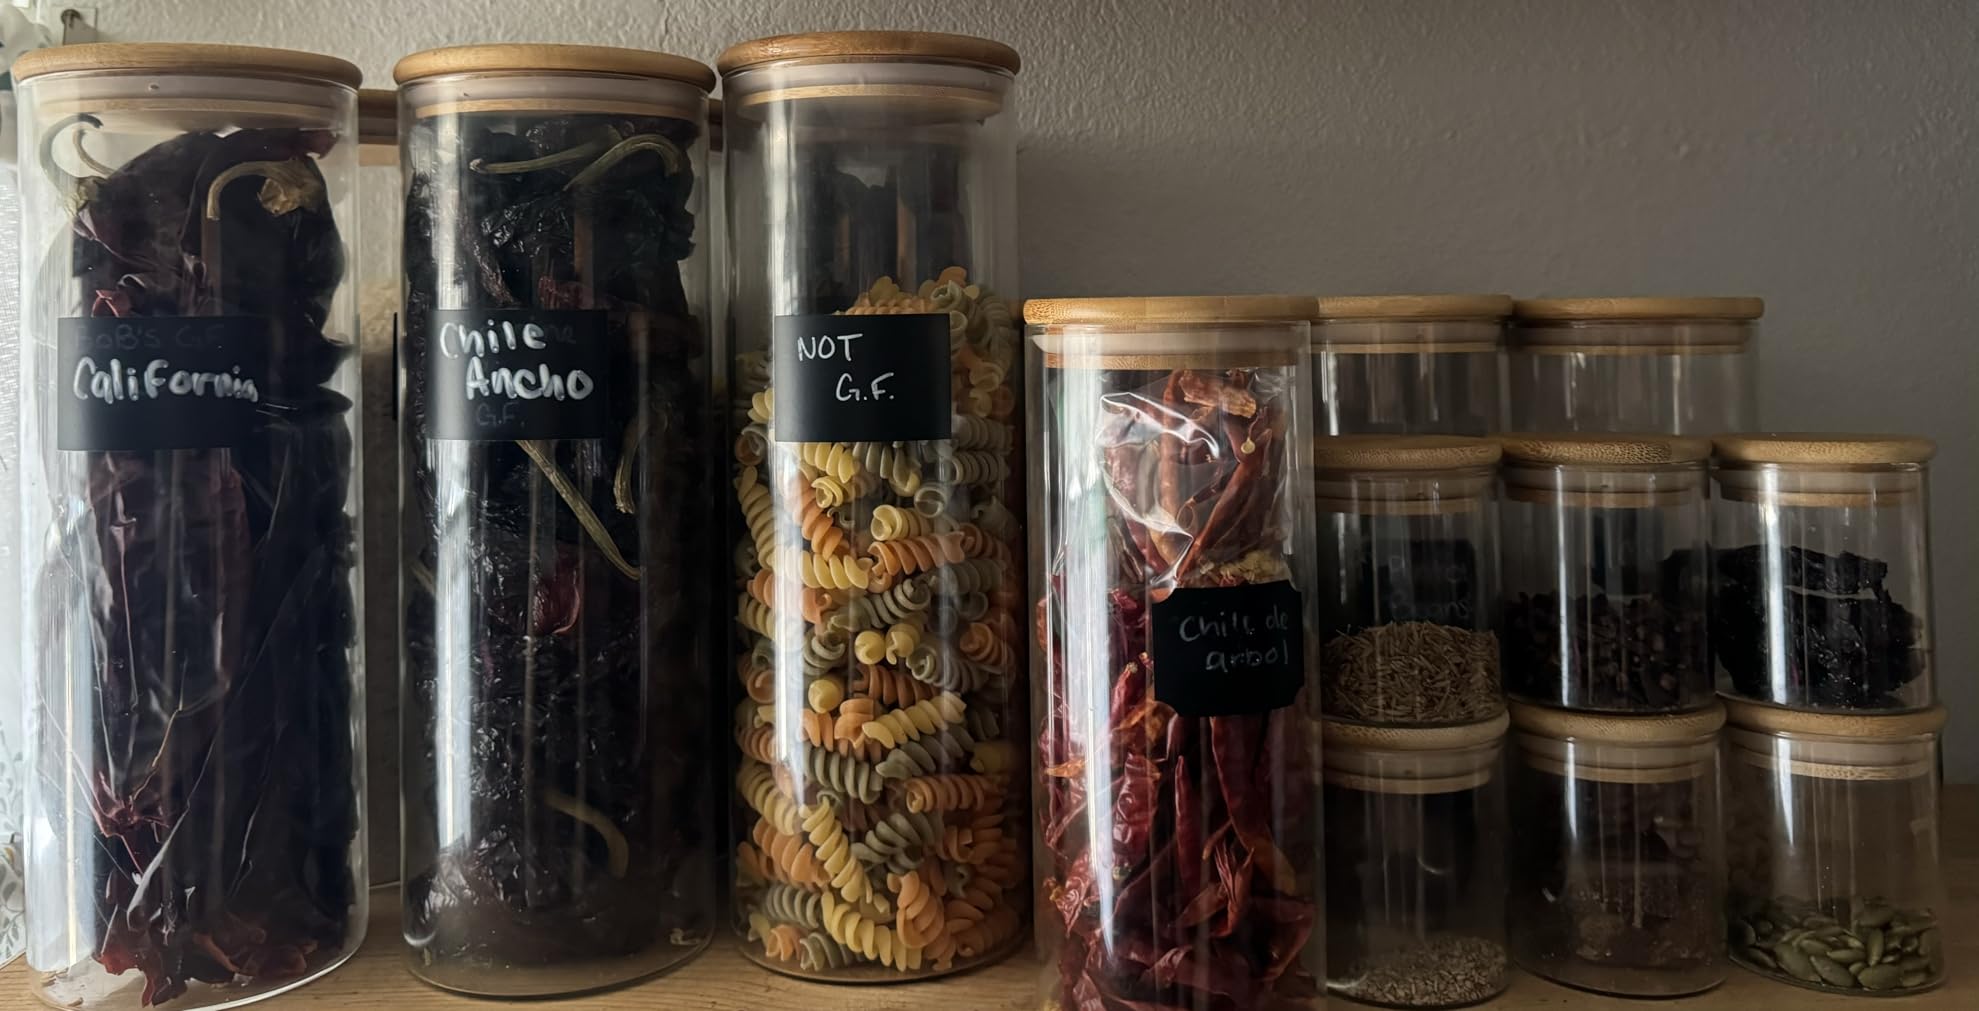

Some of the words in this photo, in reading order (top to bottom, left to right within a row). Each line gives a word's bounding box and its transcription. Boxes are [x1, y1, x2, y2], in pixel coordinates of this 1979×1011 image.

[439, 318, 547, 358] Chile
[797, 333, 864, 362] NOT
[465, 355, 595, 402] Ancho
[835, 371, 895, 402] G.F.
[1265, 602, 1289, 631] de
[1205, 638, 1289, 675] arbol
